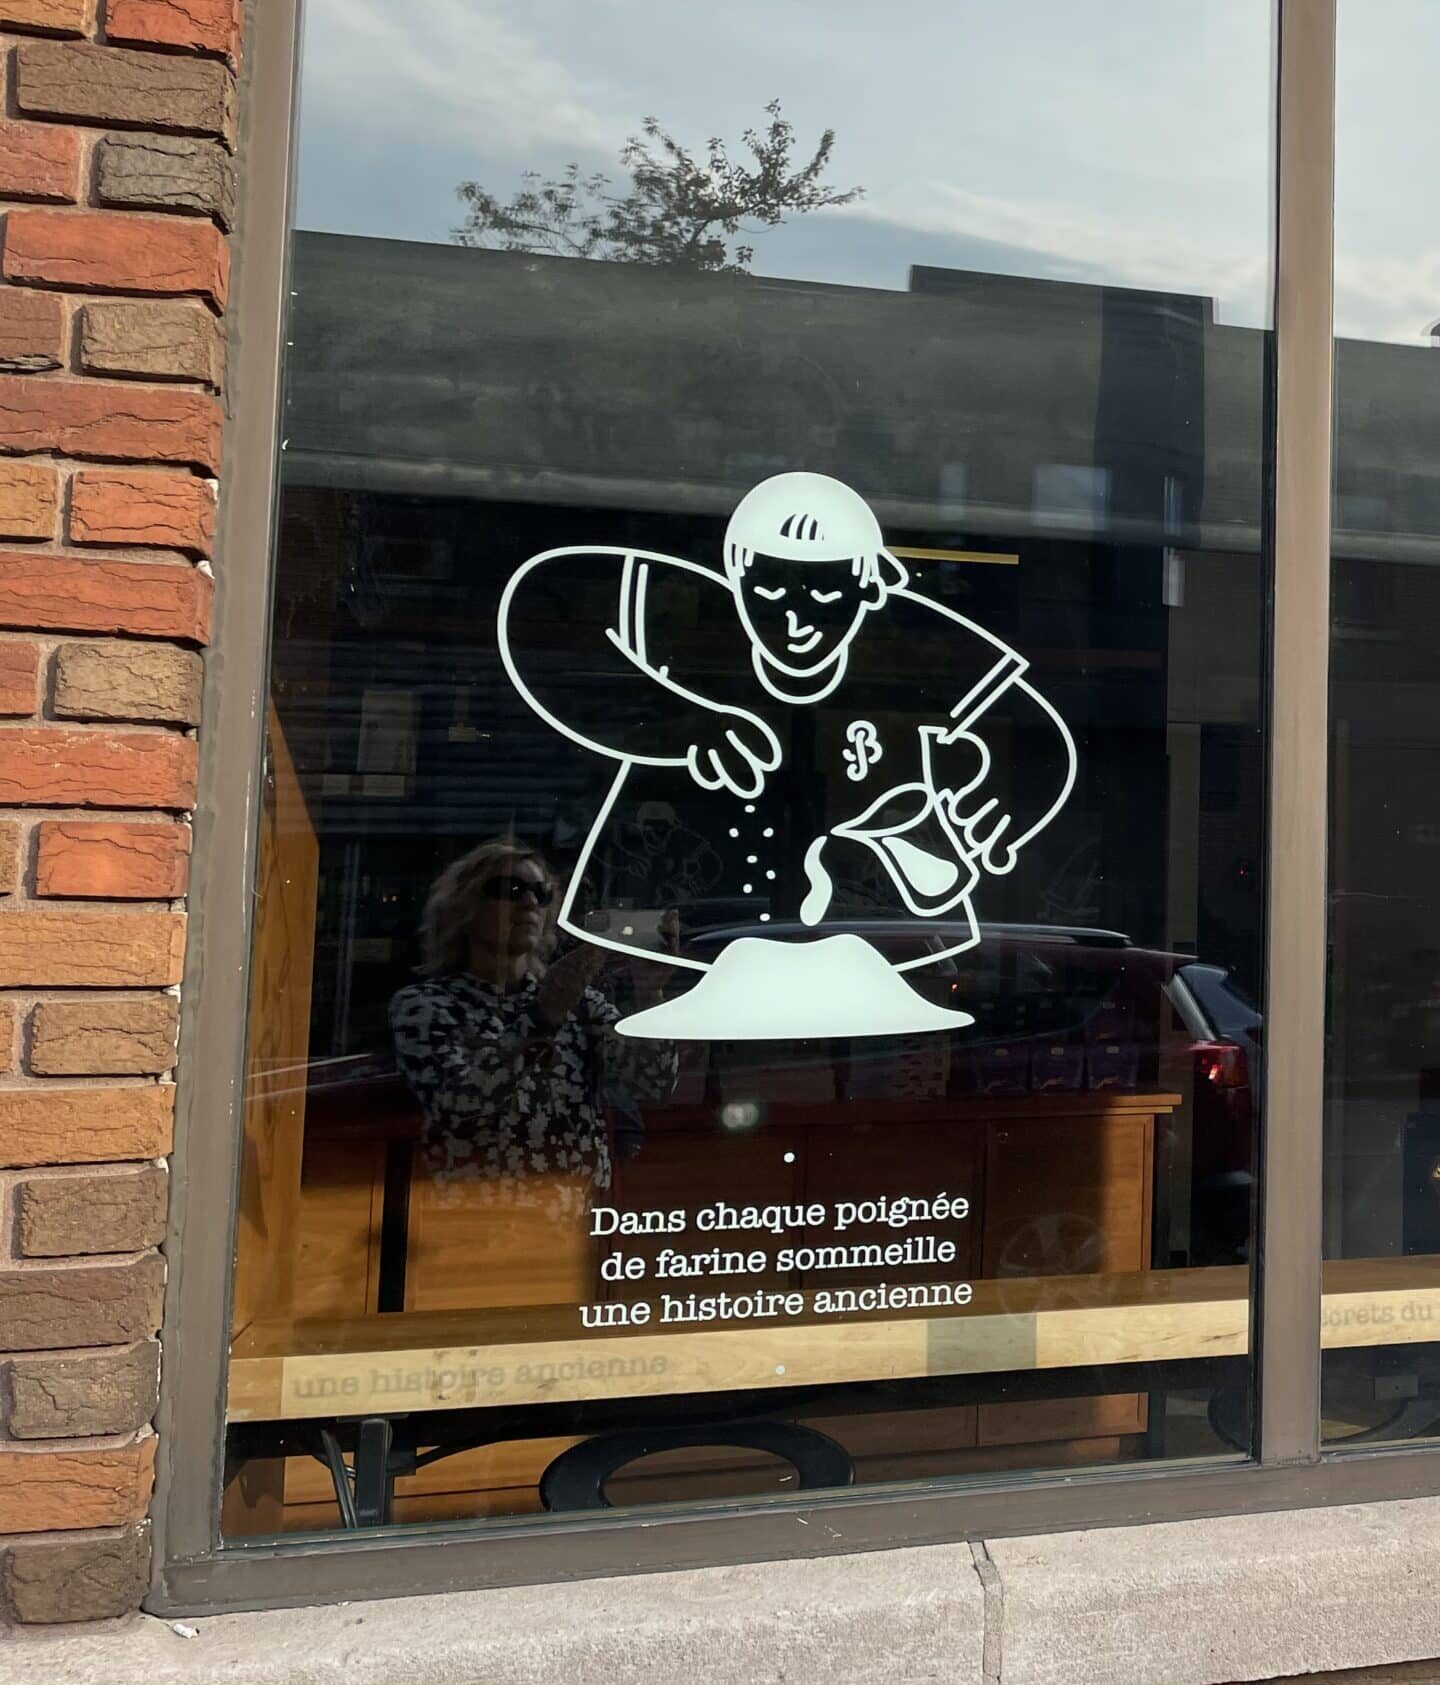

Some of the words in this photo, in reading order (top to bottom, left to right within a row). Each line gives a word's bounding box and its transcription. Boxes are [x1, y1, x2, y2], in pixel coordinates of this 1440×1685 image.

[589, 1207, 686, 1236] Dans
[696, 1202, 826, 1234] chaque
[834, 1192, 969, 1231] poignée
[601, 1252, 646, 1282] de
[655, 1248, 767, 1278] farine
[776, 1236, 956, 1272] sommeille
[579, 1300, 651, 1329] une
[660, 1292, 803, 1324] histoire
[813, 1282, 973, 1313] ancienne
[1401, 1301, 1432, 1322] du
[290, 1375, 358, 1399] une
[370, 1361, 506, 1394] histoire
[515, 1355, 667, 1386] ancienne
